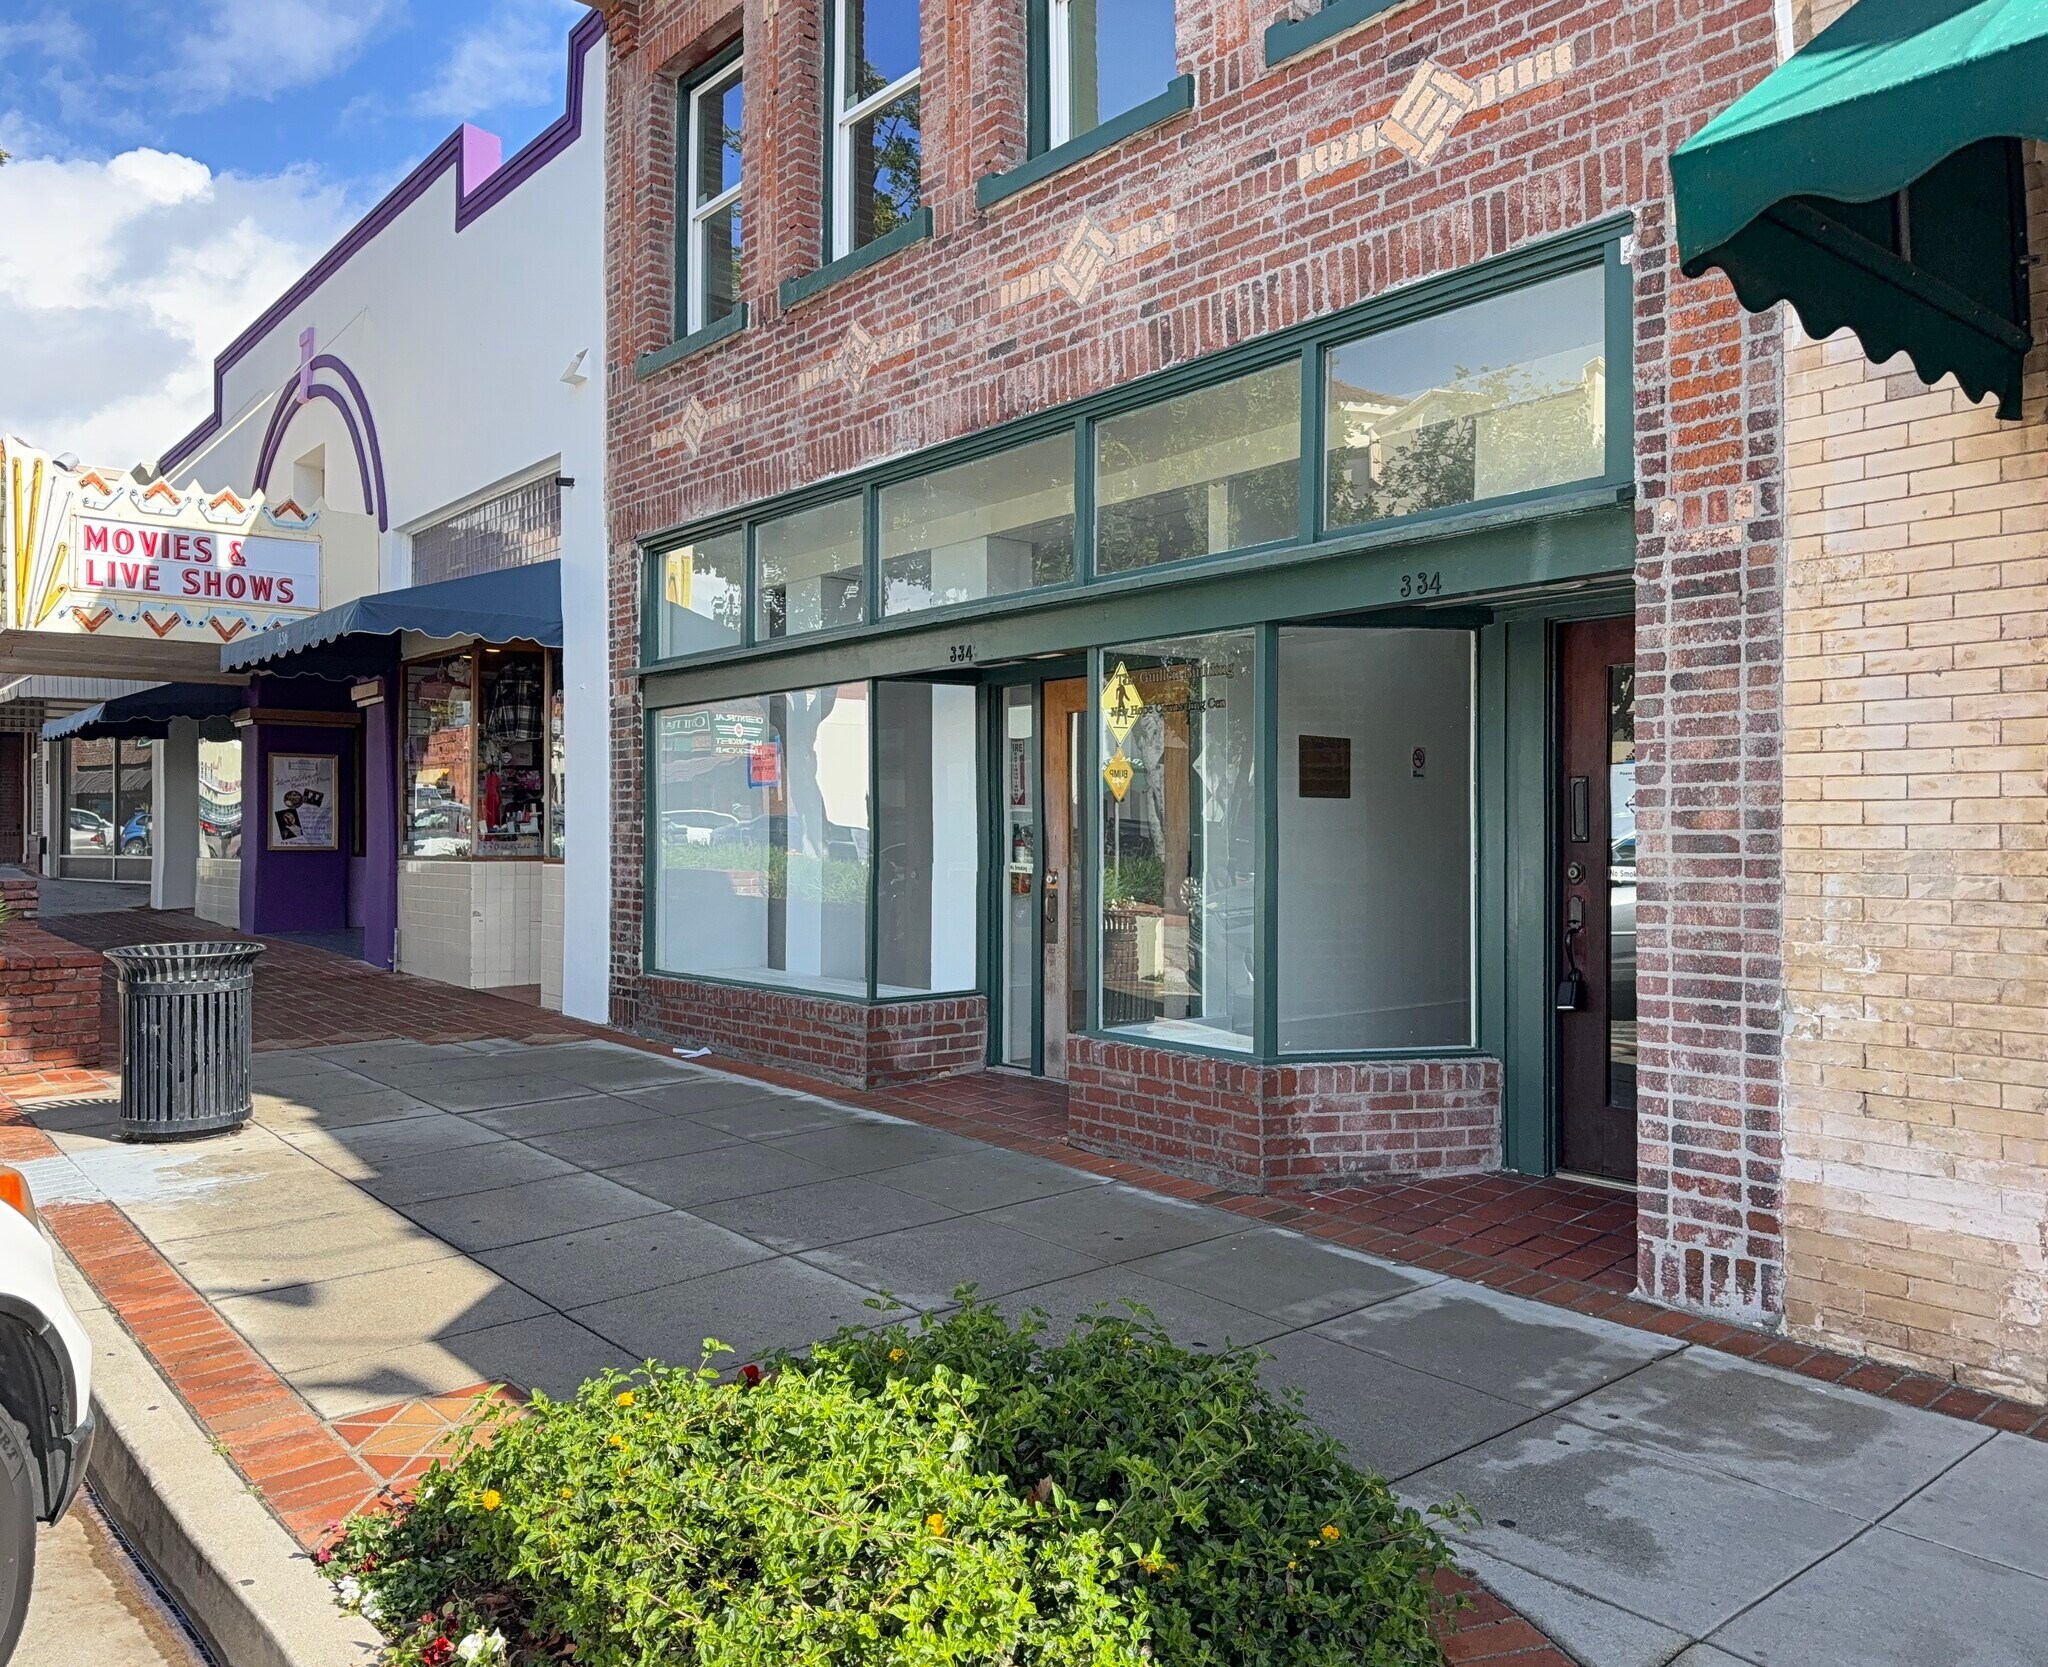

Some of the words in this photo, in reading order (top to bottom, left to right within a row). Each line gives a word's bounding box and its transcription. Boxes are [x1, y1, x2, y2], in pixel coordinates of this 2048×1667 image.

[84, 524, 212, 563] MOVIES
[228, 540, 247, 567] &
[86, 559, 160, 591] LIVE
[181, 568, 294, 604] SHOWS
[1400, 571, 1442, 598] 334
[949, 644, 973, 663] 334
[1130, 703, 1153, 718] Hope
